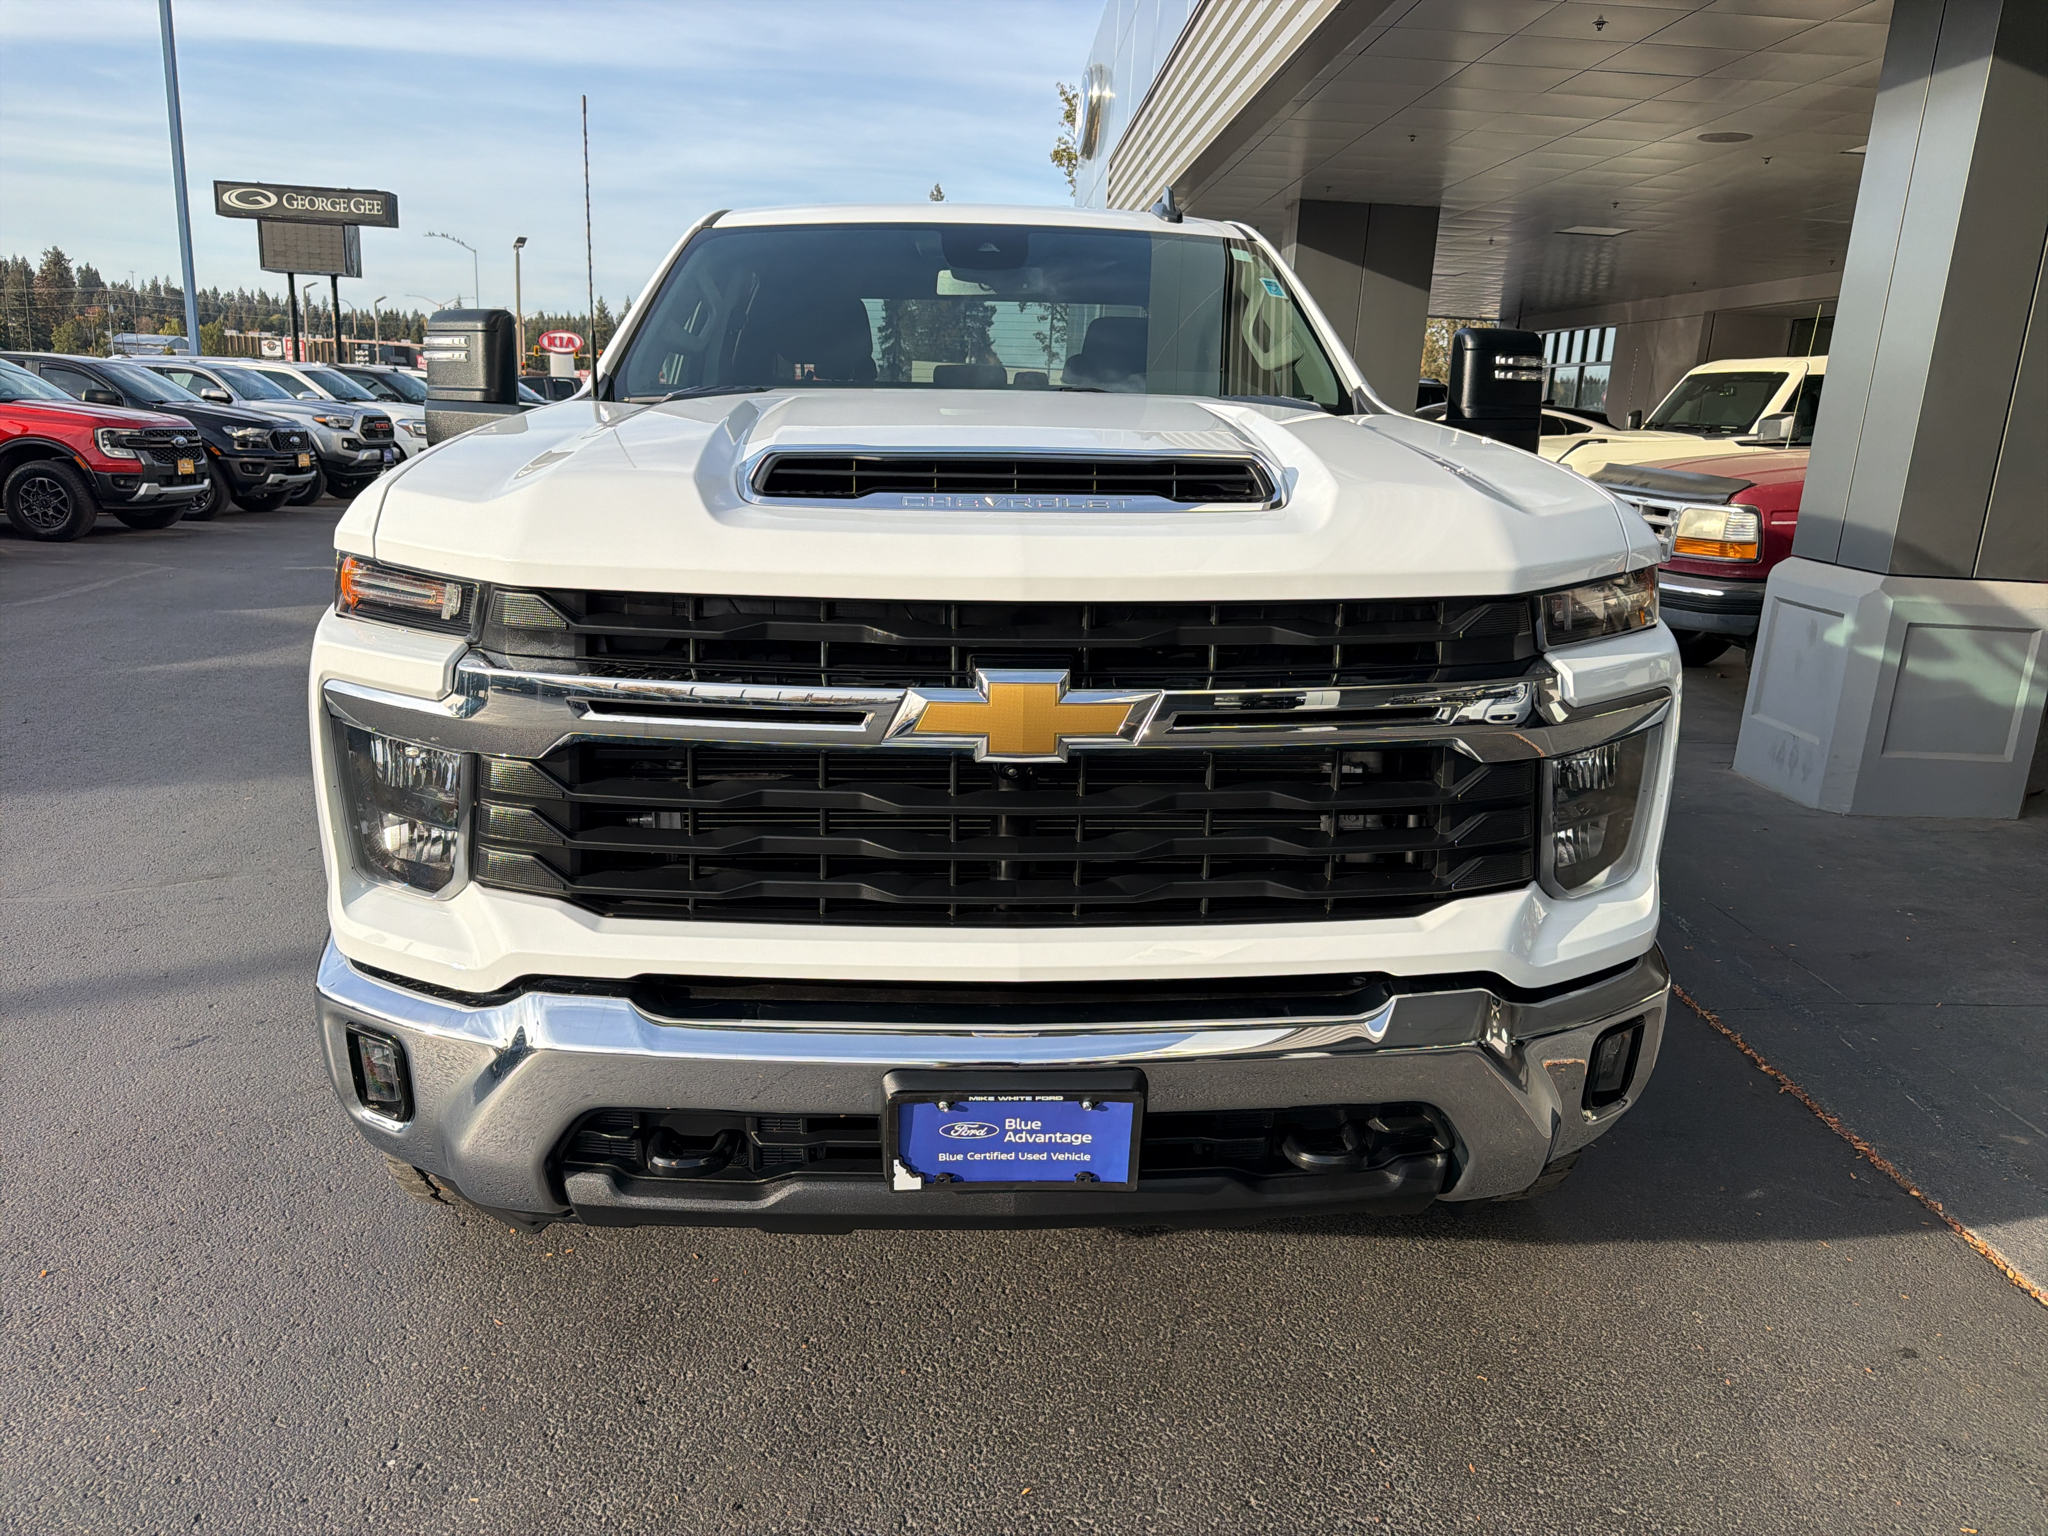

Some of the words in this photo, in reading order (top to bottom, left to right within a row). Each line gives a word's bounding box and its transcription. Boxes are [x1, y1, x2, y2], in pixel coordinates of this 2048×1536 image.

[282, 192, 349, 213] GEORGE
[350, 197, 383, 215] GEE
[546, 335, 576, 348] KIA
[900, 495, 1135, 509] CHEVROLET
[950, 1123, 988, 1137] Ford
[1004, 1118, 1042, 1130] Blue
[1003, 1131, 1093, 1145] Advantage
[938, 1152, 964, 1162] Blue
[967, 1151, 1015, 1161] Certified
[1018, 1151, 1048, 1161] Used
[1051, 1151, 1091, 1162] Vehicle
